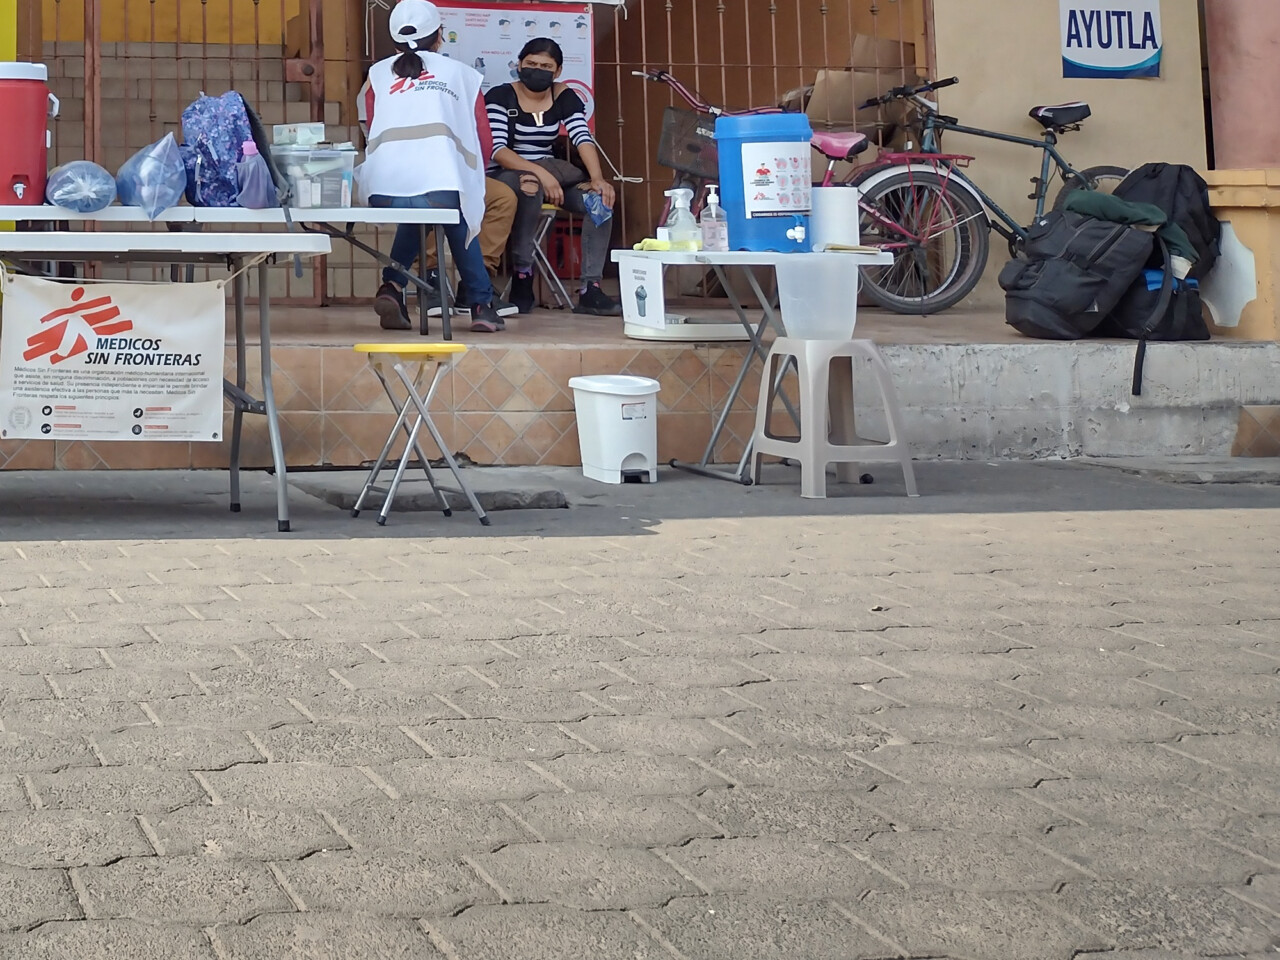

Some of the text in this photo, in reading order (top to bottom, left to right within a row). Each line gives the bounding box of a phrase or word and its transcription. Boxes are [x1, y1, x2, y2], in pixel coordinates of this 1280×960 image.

[1066, 10, 1158, 50] AYUTLA
[426, 86, 460, 100] FRONTERAS
[96, 338, 162, 350] MEDICOS
[84, 352, 202, 366] SIN FRONTERAS
